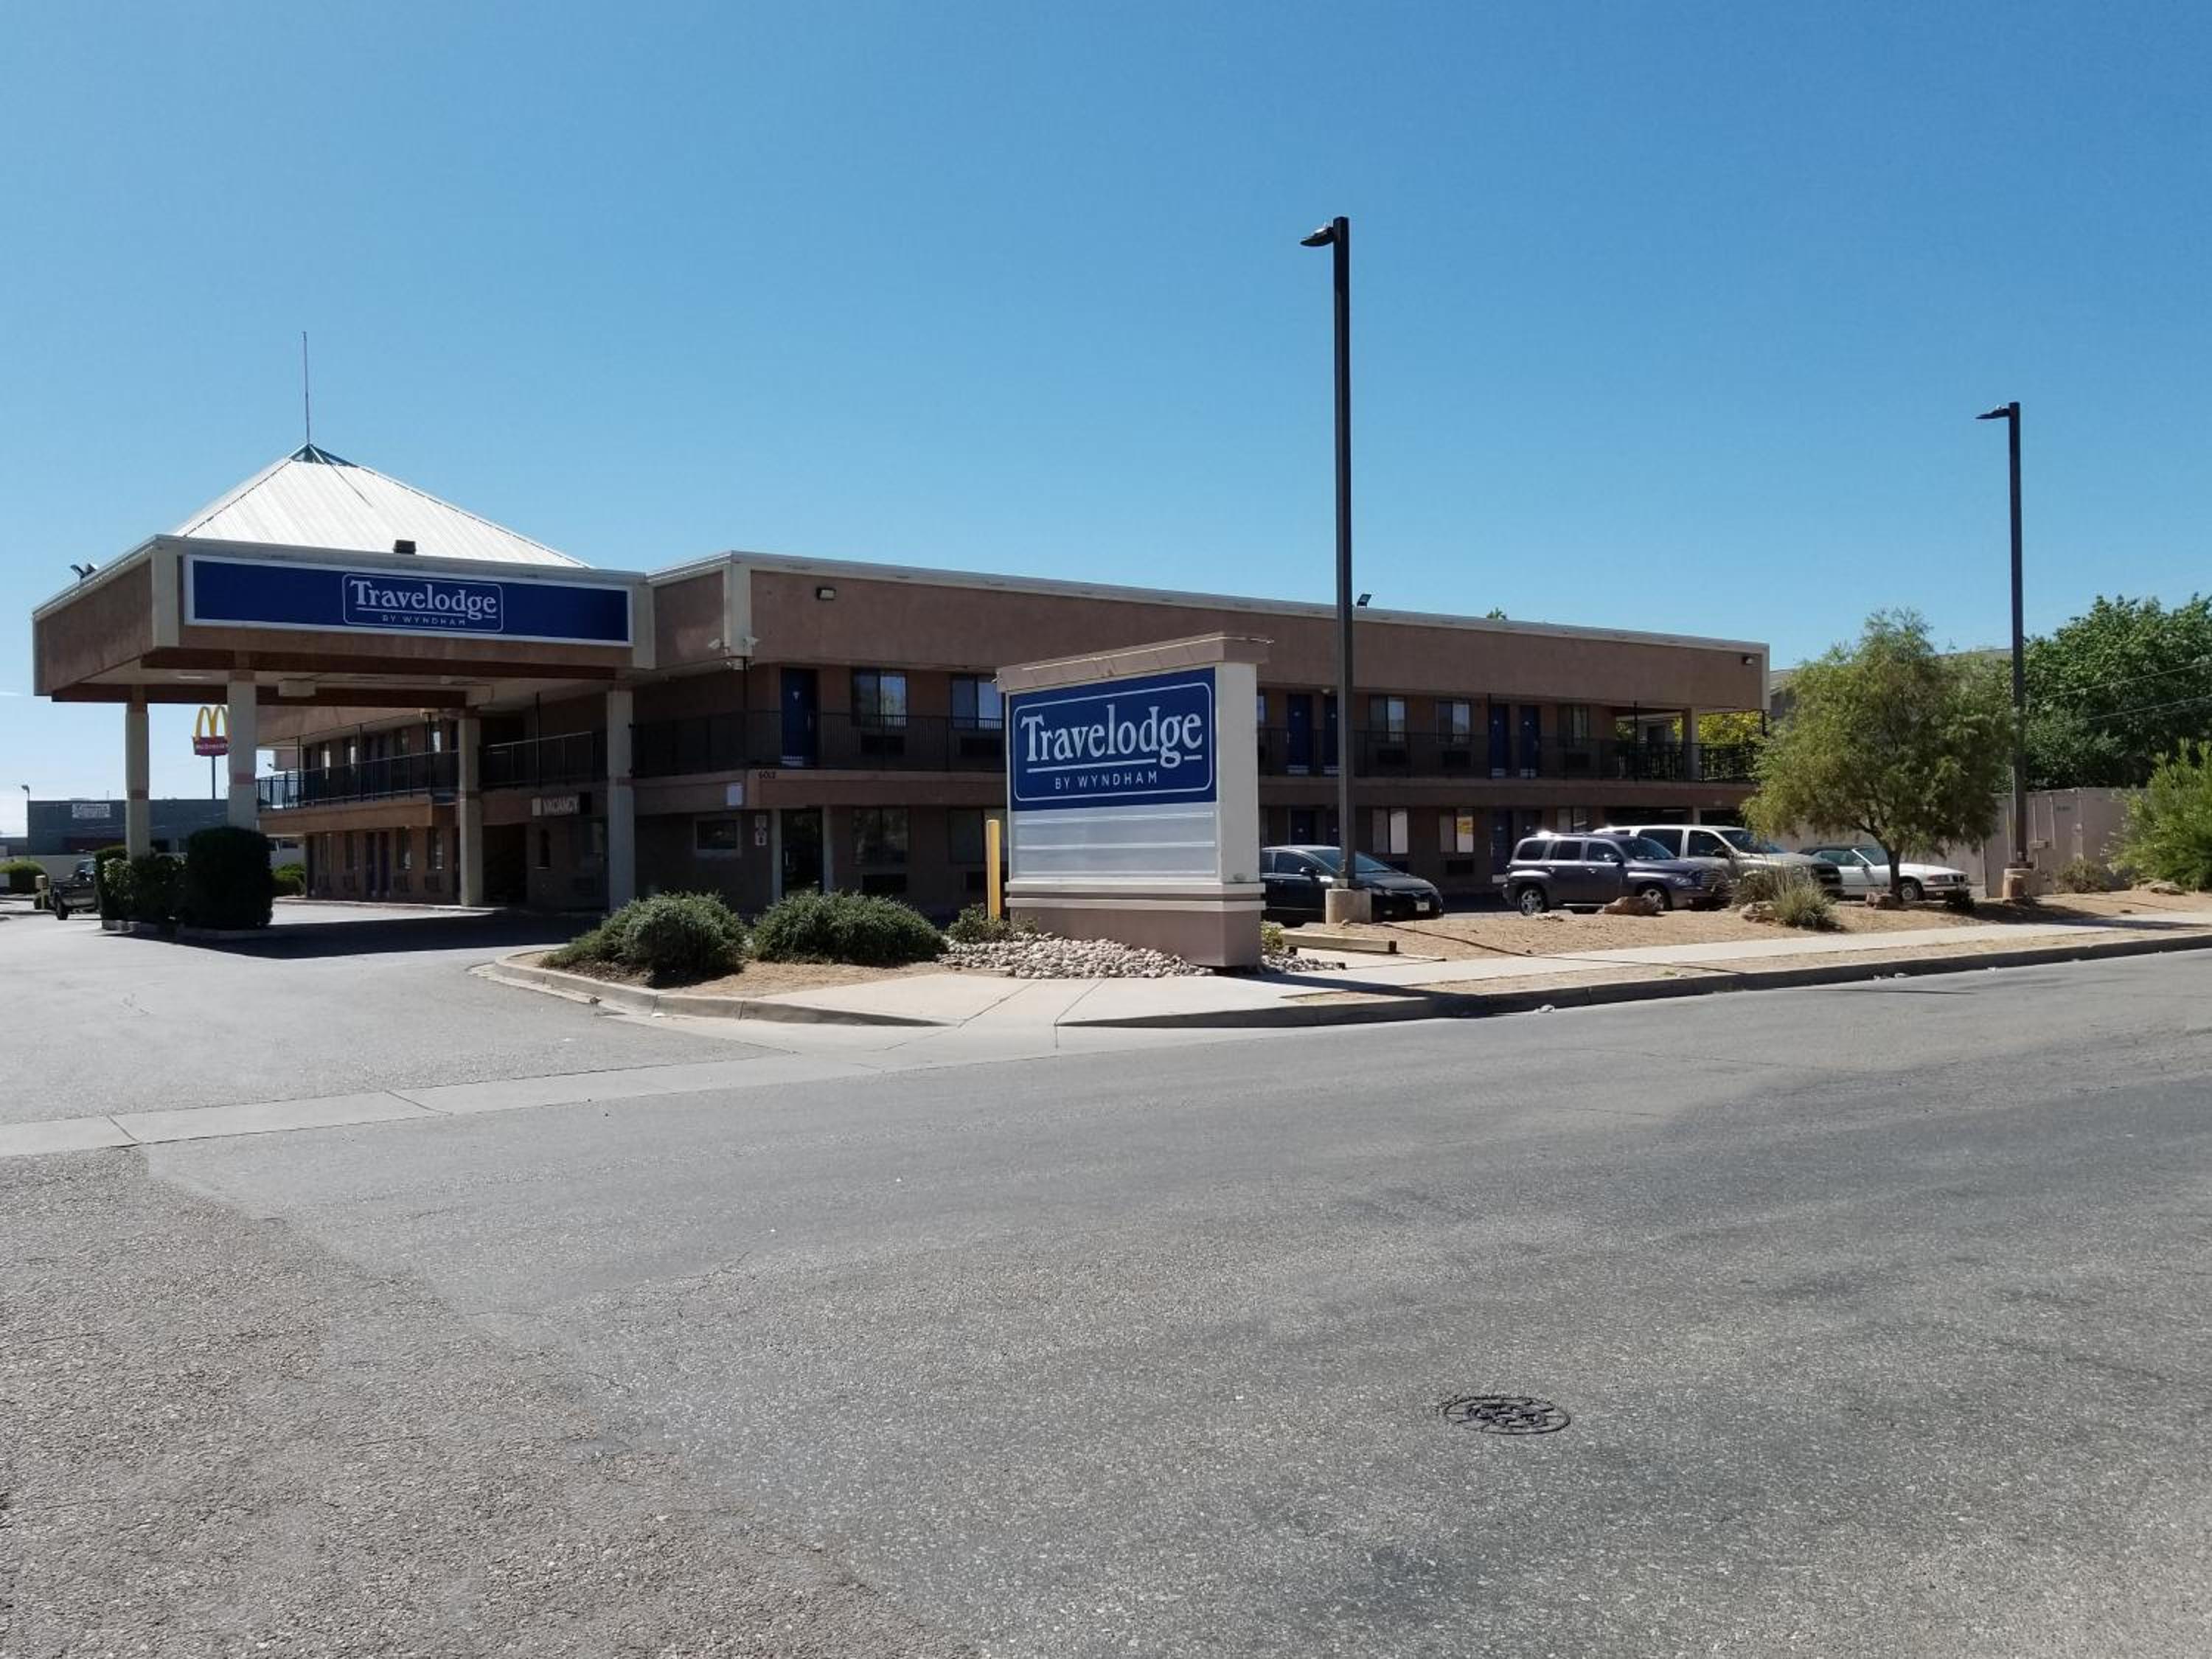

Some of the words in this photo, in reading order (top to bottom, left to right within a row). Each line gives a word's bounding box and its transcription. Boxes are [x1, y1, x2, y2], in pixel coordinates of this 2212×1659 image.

[349, 580, 496, 620] Travelodge
[383, 613, 396, 622] BY
[403, 616, 466, 626] WYNDHAM
[1020, 704, 1203, 768] Travelodge
[1055, 778, 1070, 790] BY
[1079, 771, 1158, 789] WYNDHAM
